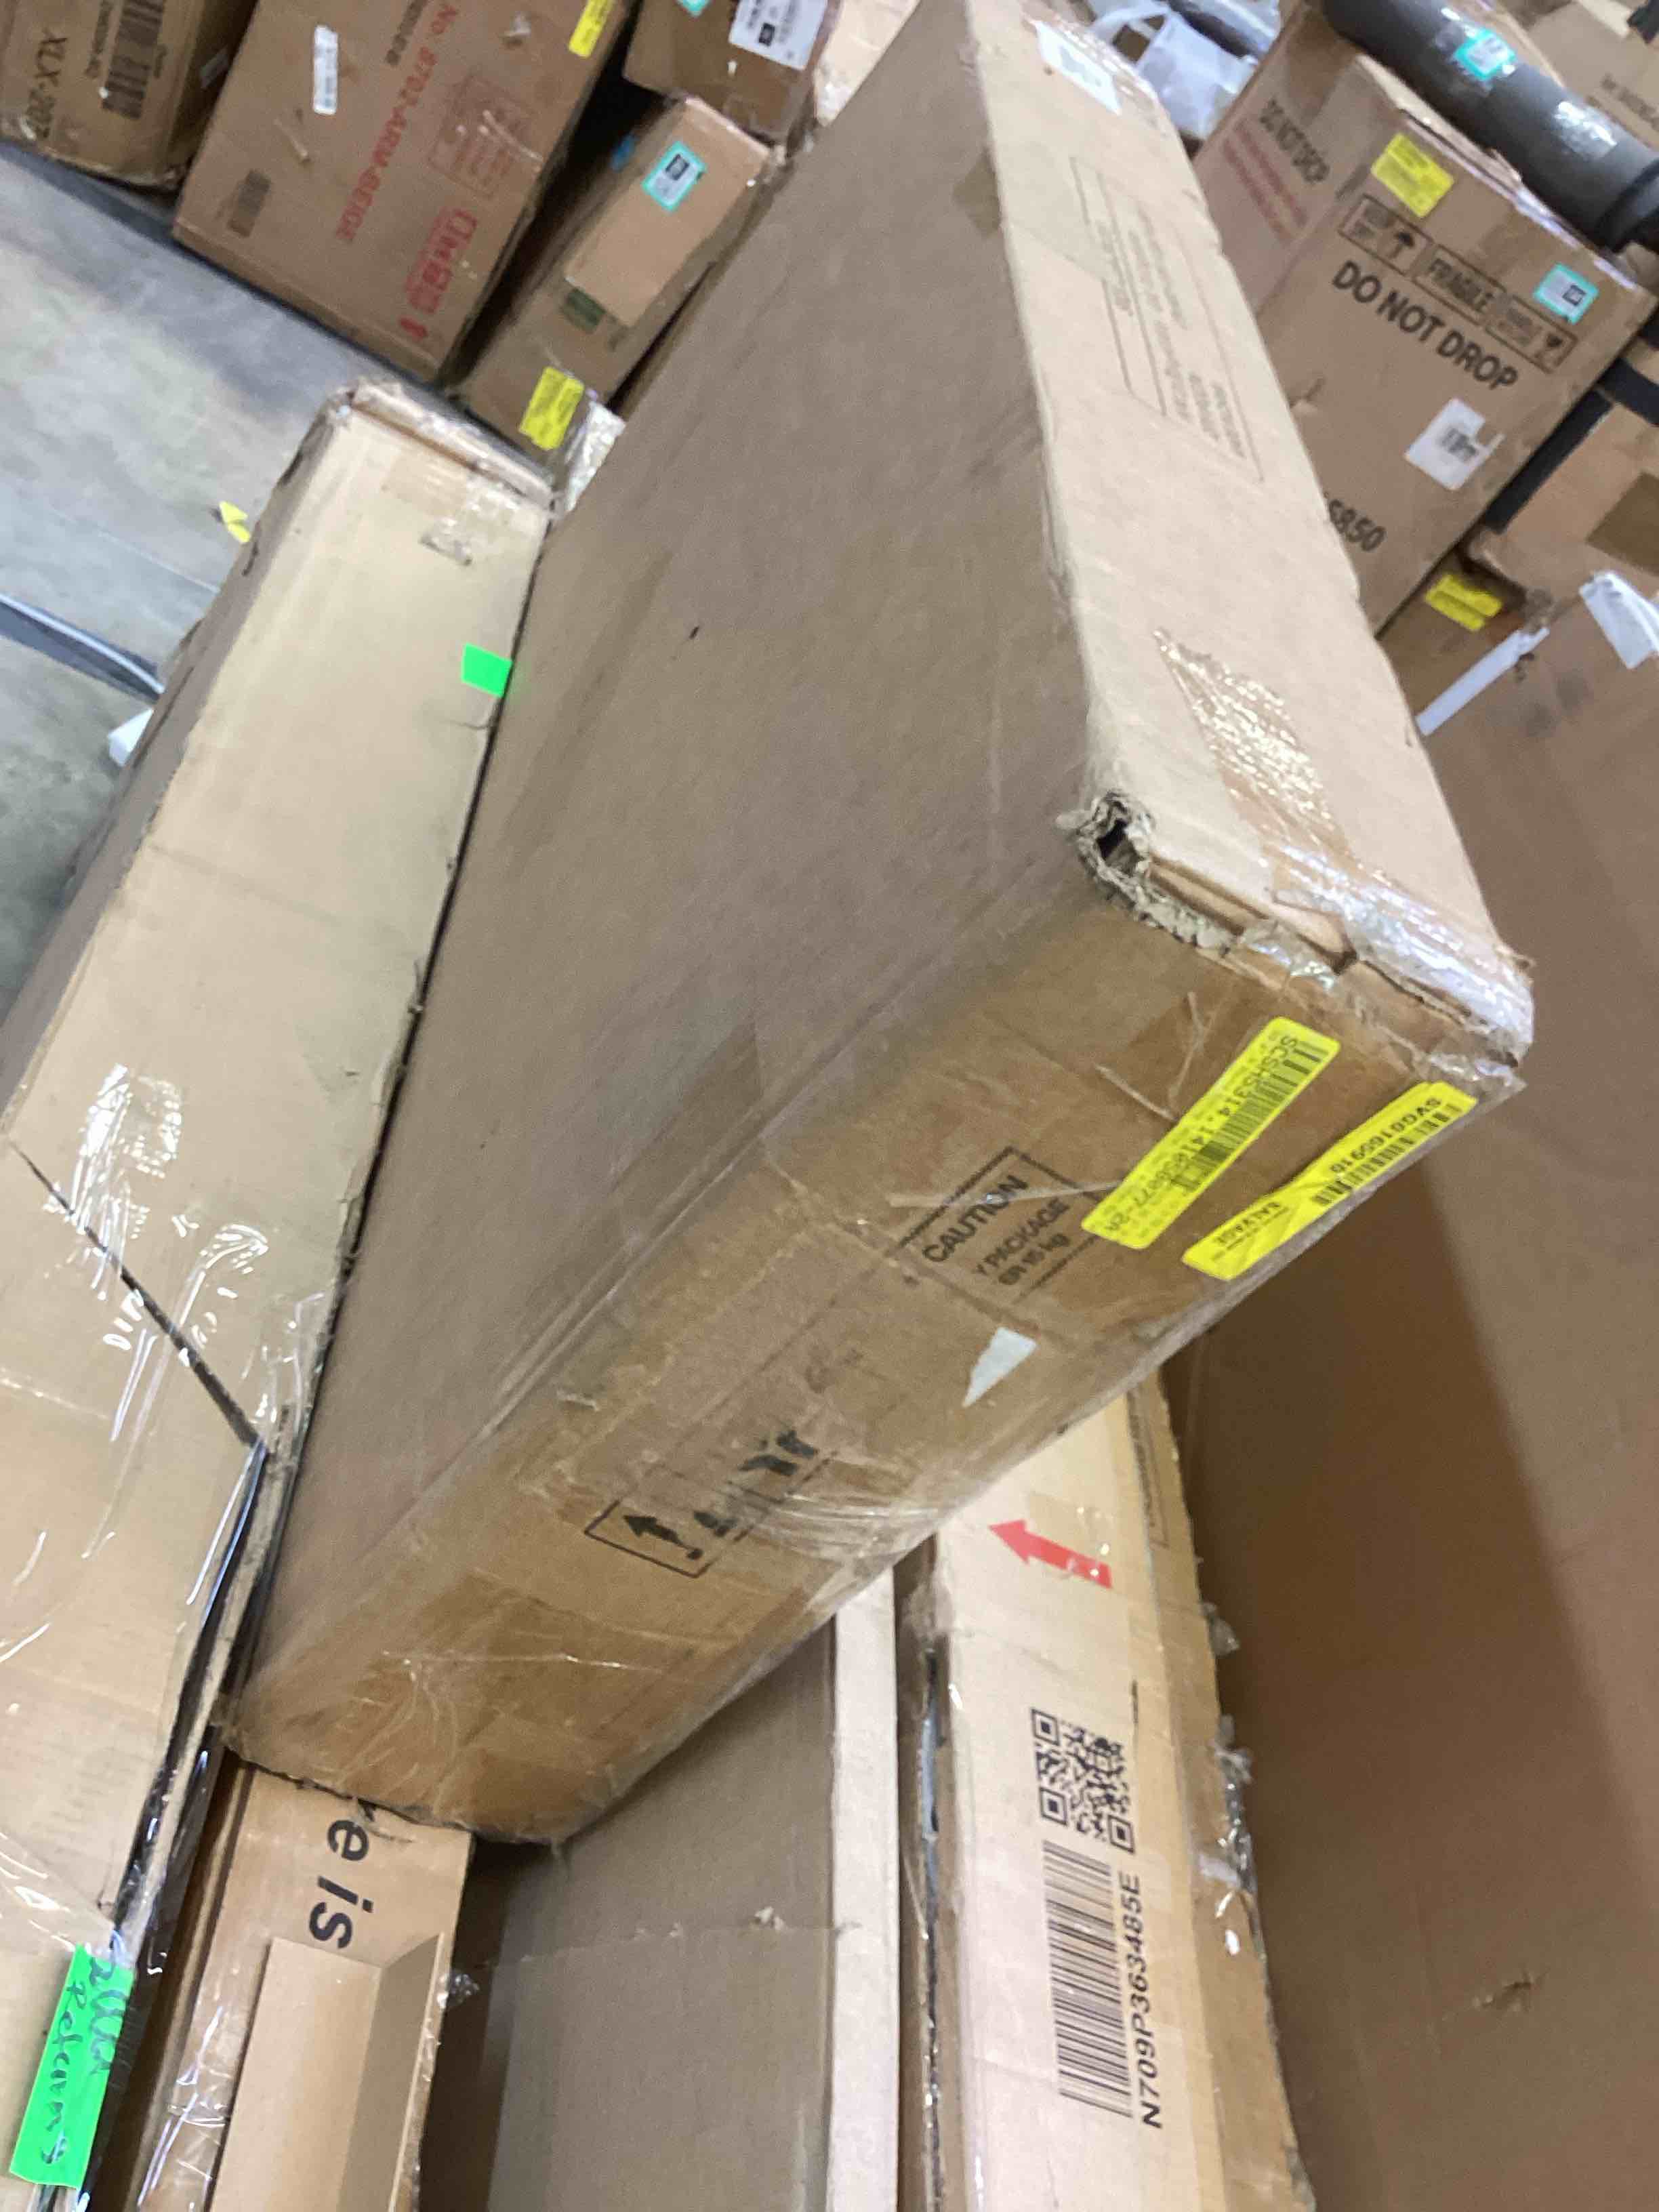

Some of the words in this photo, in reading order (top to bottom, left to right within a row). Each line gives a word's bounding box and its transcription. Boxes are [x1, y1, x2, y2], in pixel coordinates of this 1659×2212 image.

[1332, 260, 1380, 303] DO
[1378, 289, 1445, 342] NOT
[1436, 331, 1519, 390] DROP
[923, 1174, 1028, 1262] CAUTION
[309, 1875, 374, 1949] is
